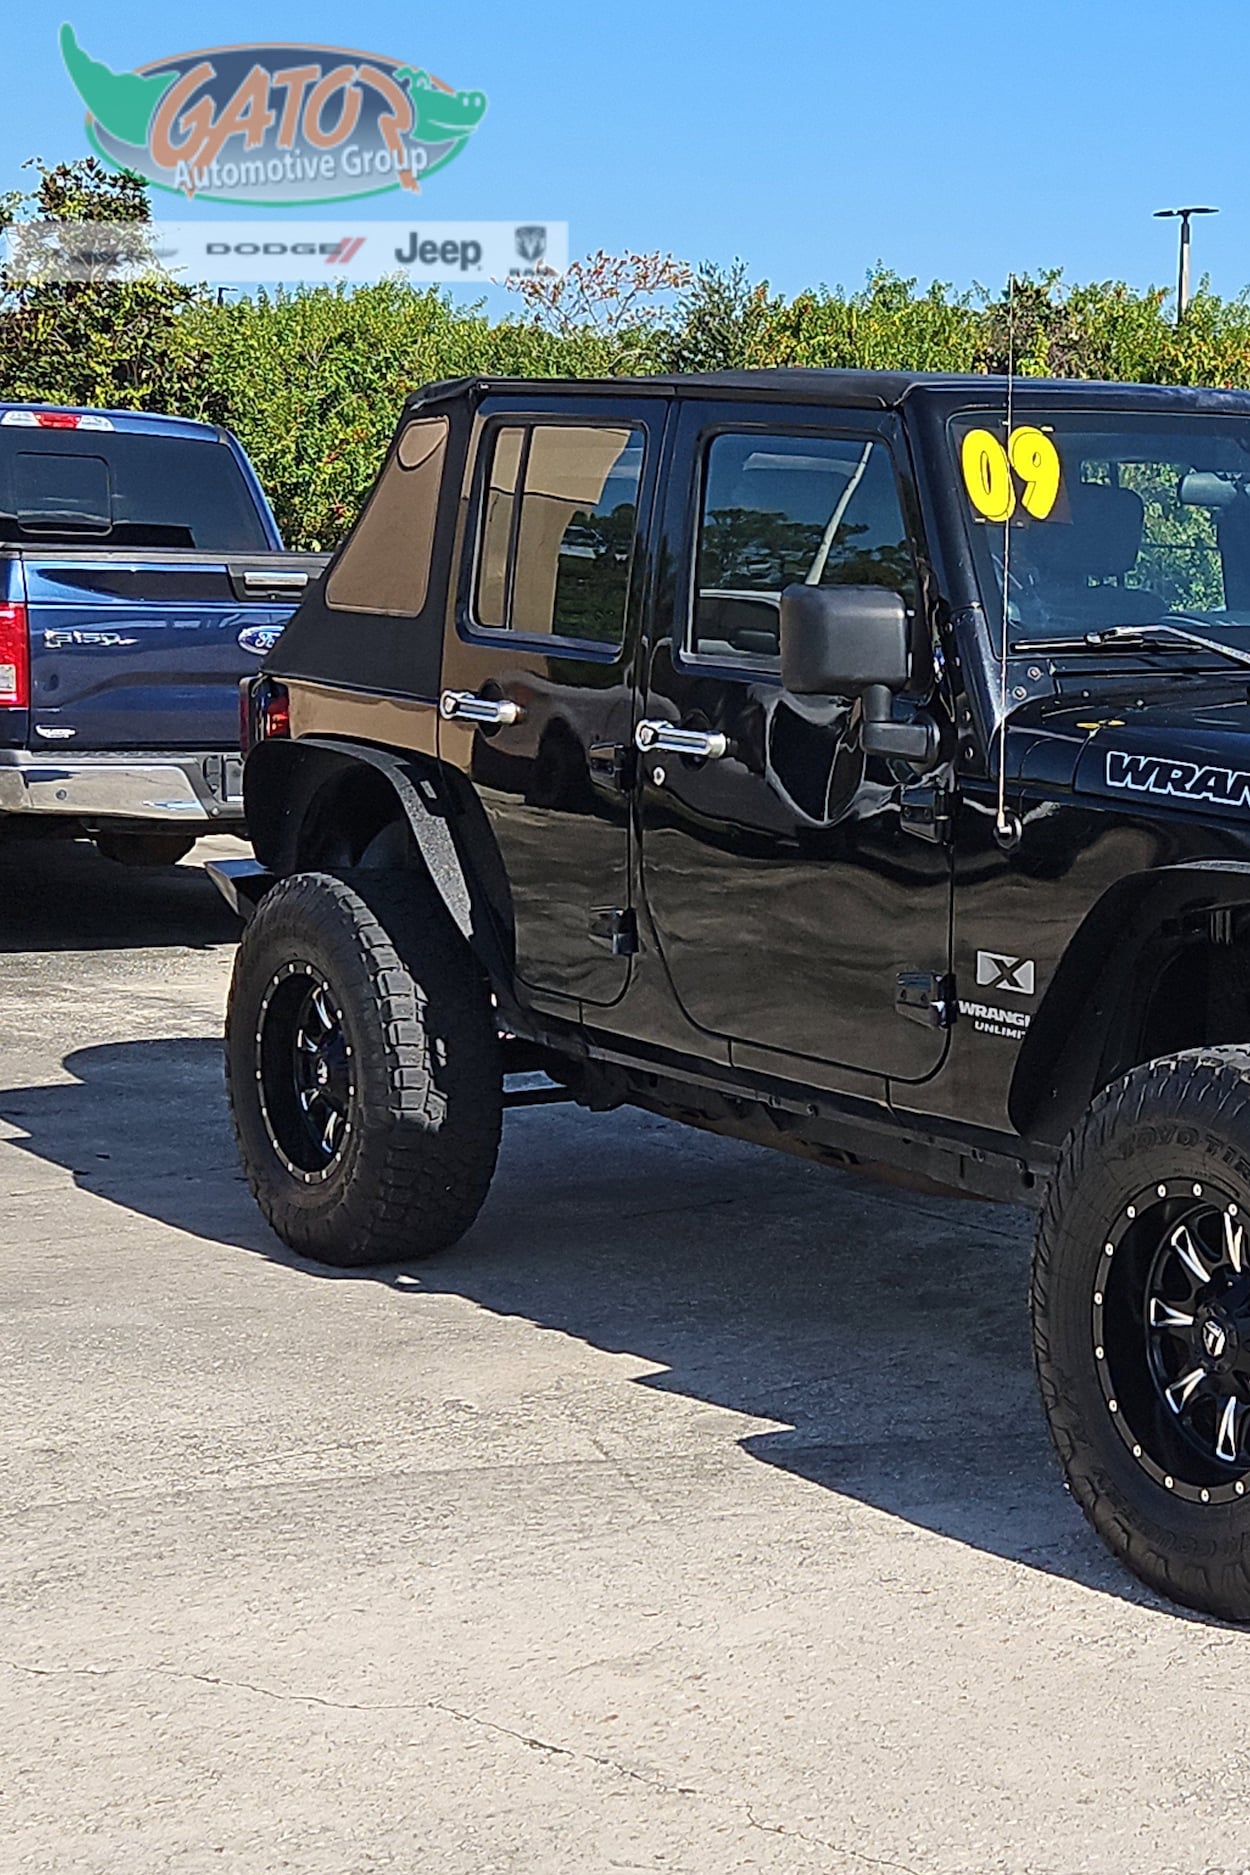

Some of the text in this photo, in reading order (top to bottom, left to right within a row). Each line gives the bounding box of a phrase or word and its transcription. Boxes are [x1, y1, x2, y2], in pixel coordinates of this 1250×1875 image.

[962, 425, 1060, 522] 09
[958, 1000, 1031, 1027] WRANG
[974, 1021, 1026, 1039] UNLIMI
